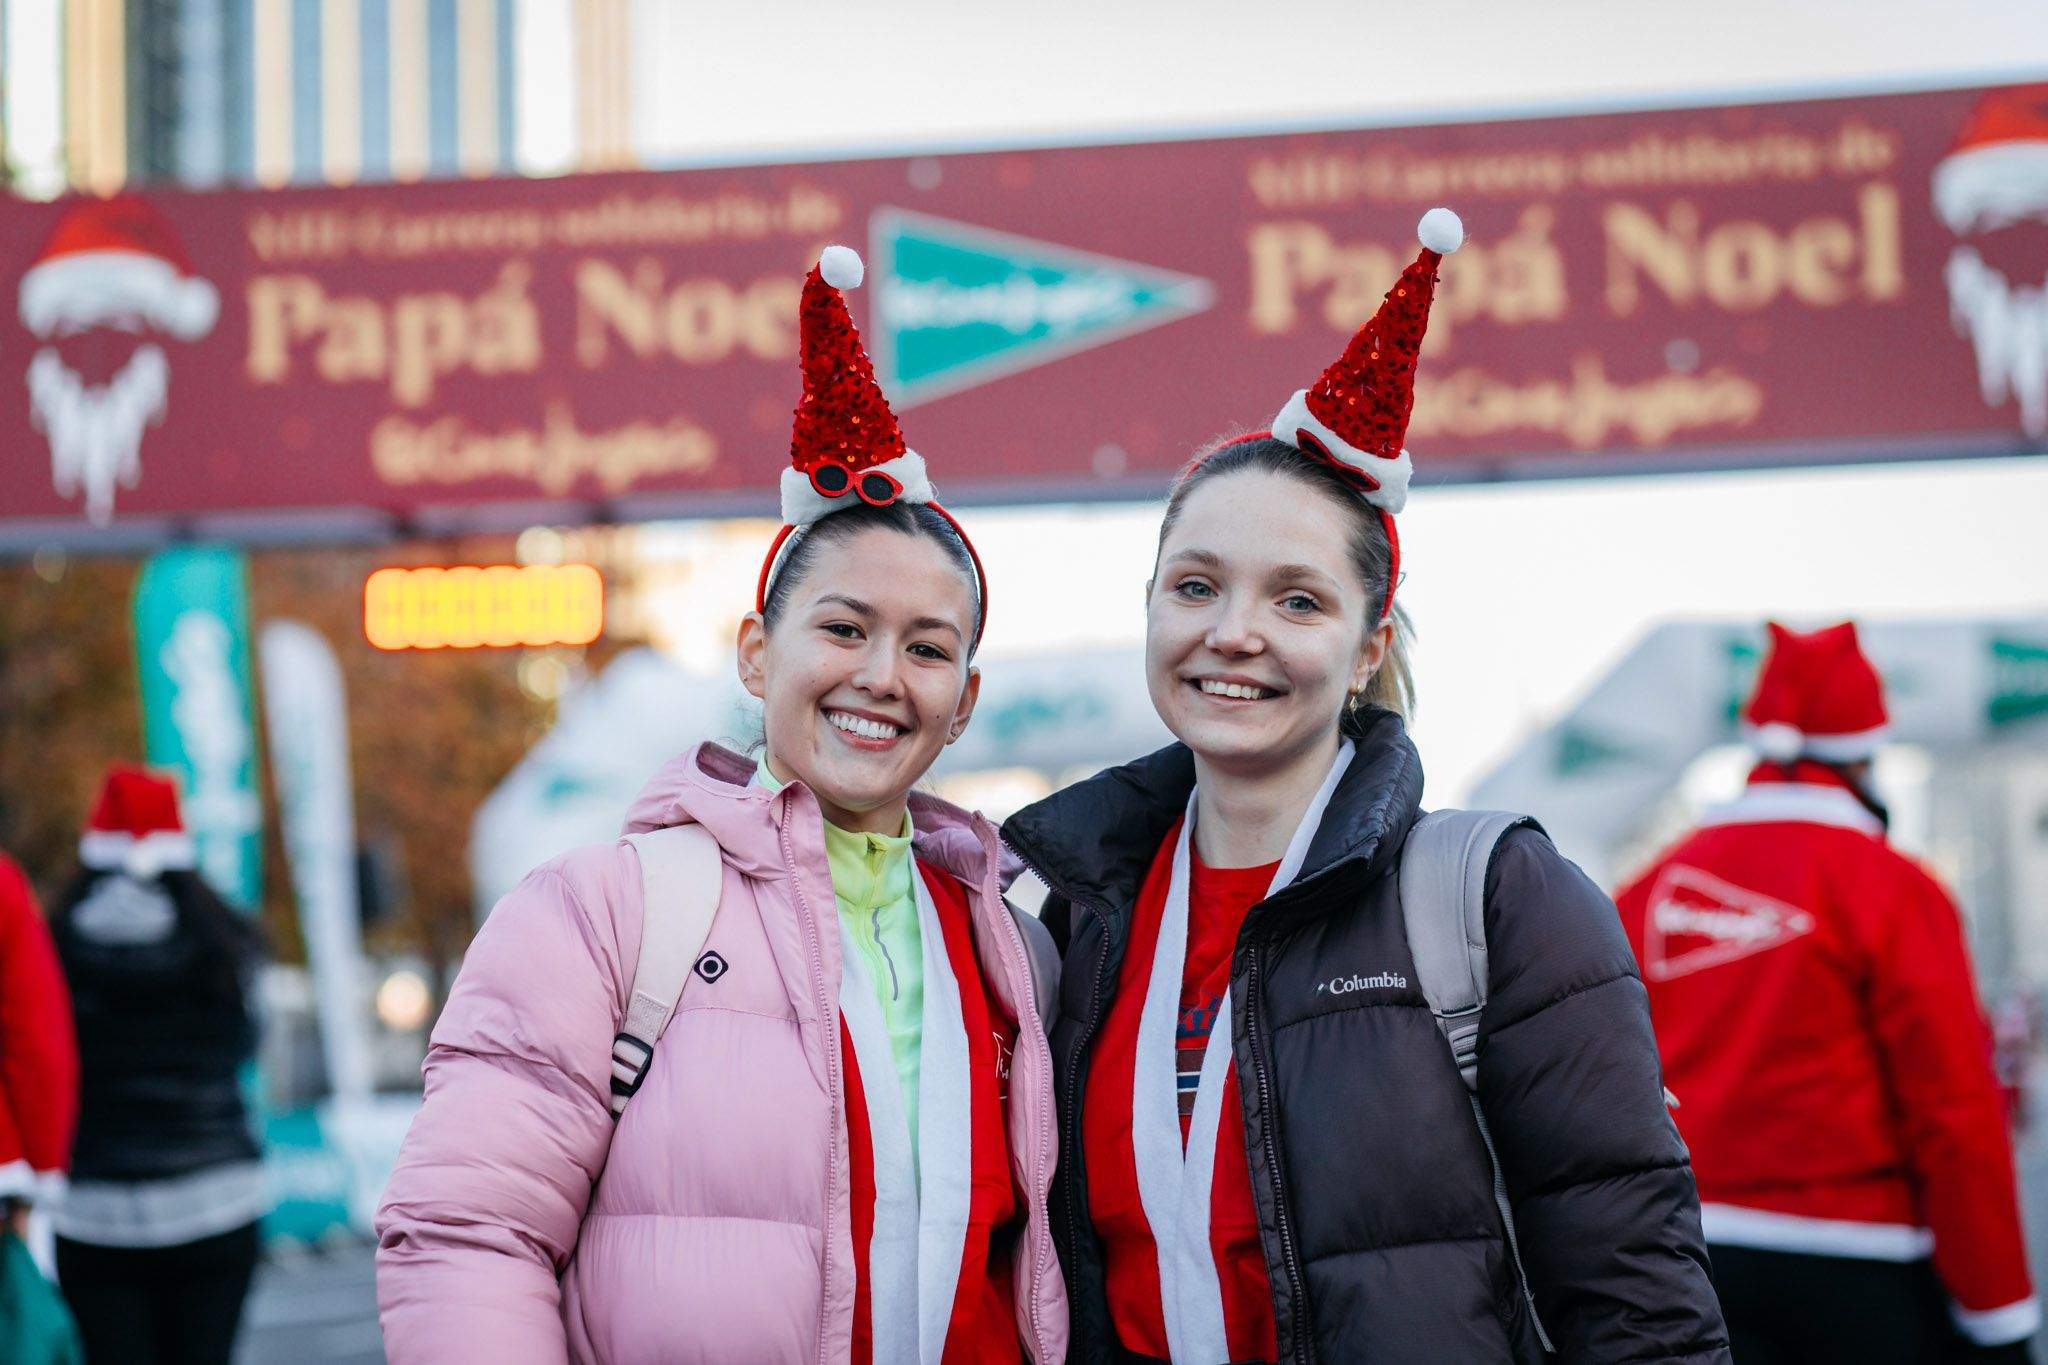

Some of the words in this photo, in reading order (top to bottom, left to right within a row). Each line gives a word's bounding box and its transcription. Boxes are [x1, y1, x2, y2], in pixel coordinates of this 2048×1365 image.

[1606, 184, 1900, 315] Noel
[248, 260, 539, 405] Papá
[576, 254, 806, 367] Noe
[1329, 971, 1407, 995] Columbia
